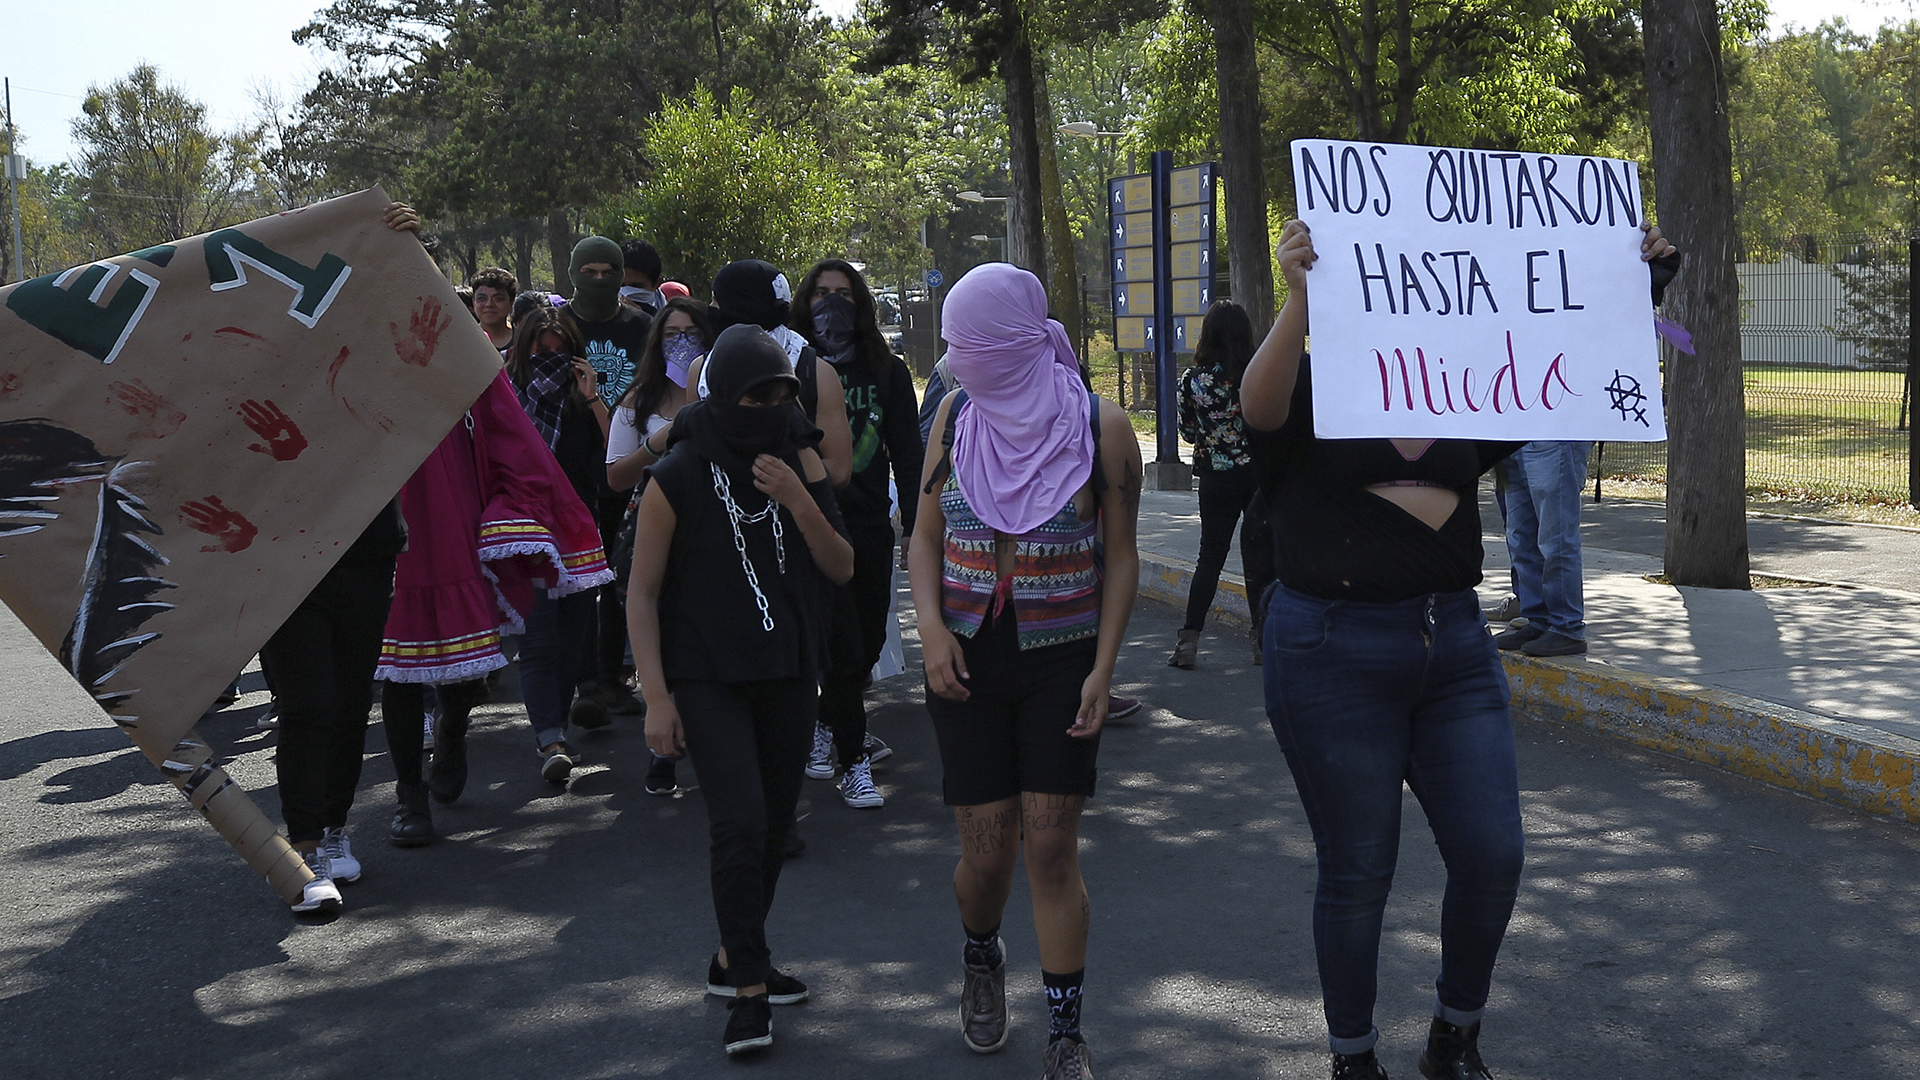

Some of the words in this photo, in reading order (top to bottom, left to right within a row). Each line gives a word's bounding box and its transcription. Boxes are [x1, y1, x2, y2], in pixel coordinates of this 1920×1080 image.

[1301, 145, 1391, 217] NOS
[1425, 149, 1639, 229] QUITARON
[1353, 242, 1499, 316] HASTA
[1526, 248, 1585, 315] EL
[843, 384, 878, 411] KLE
